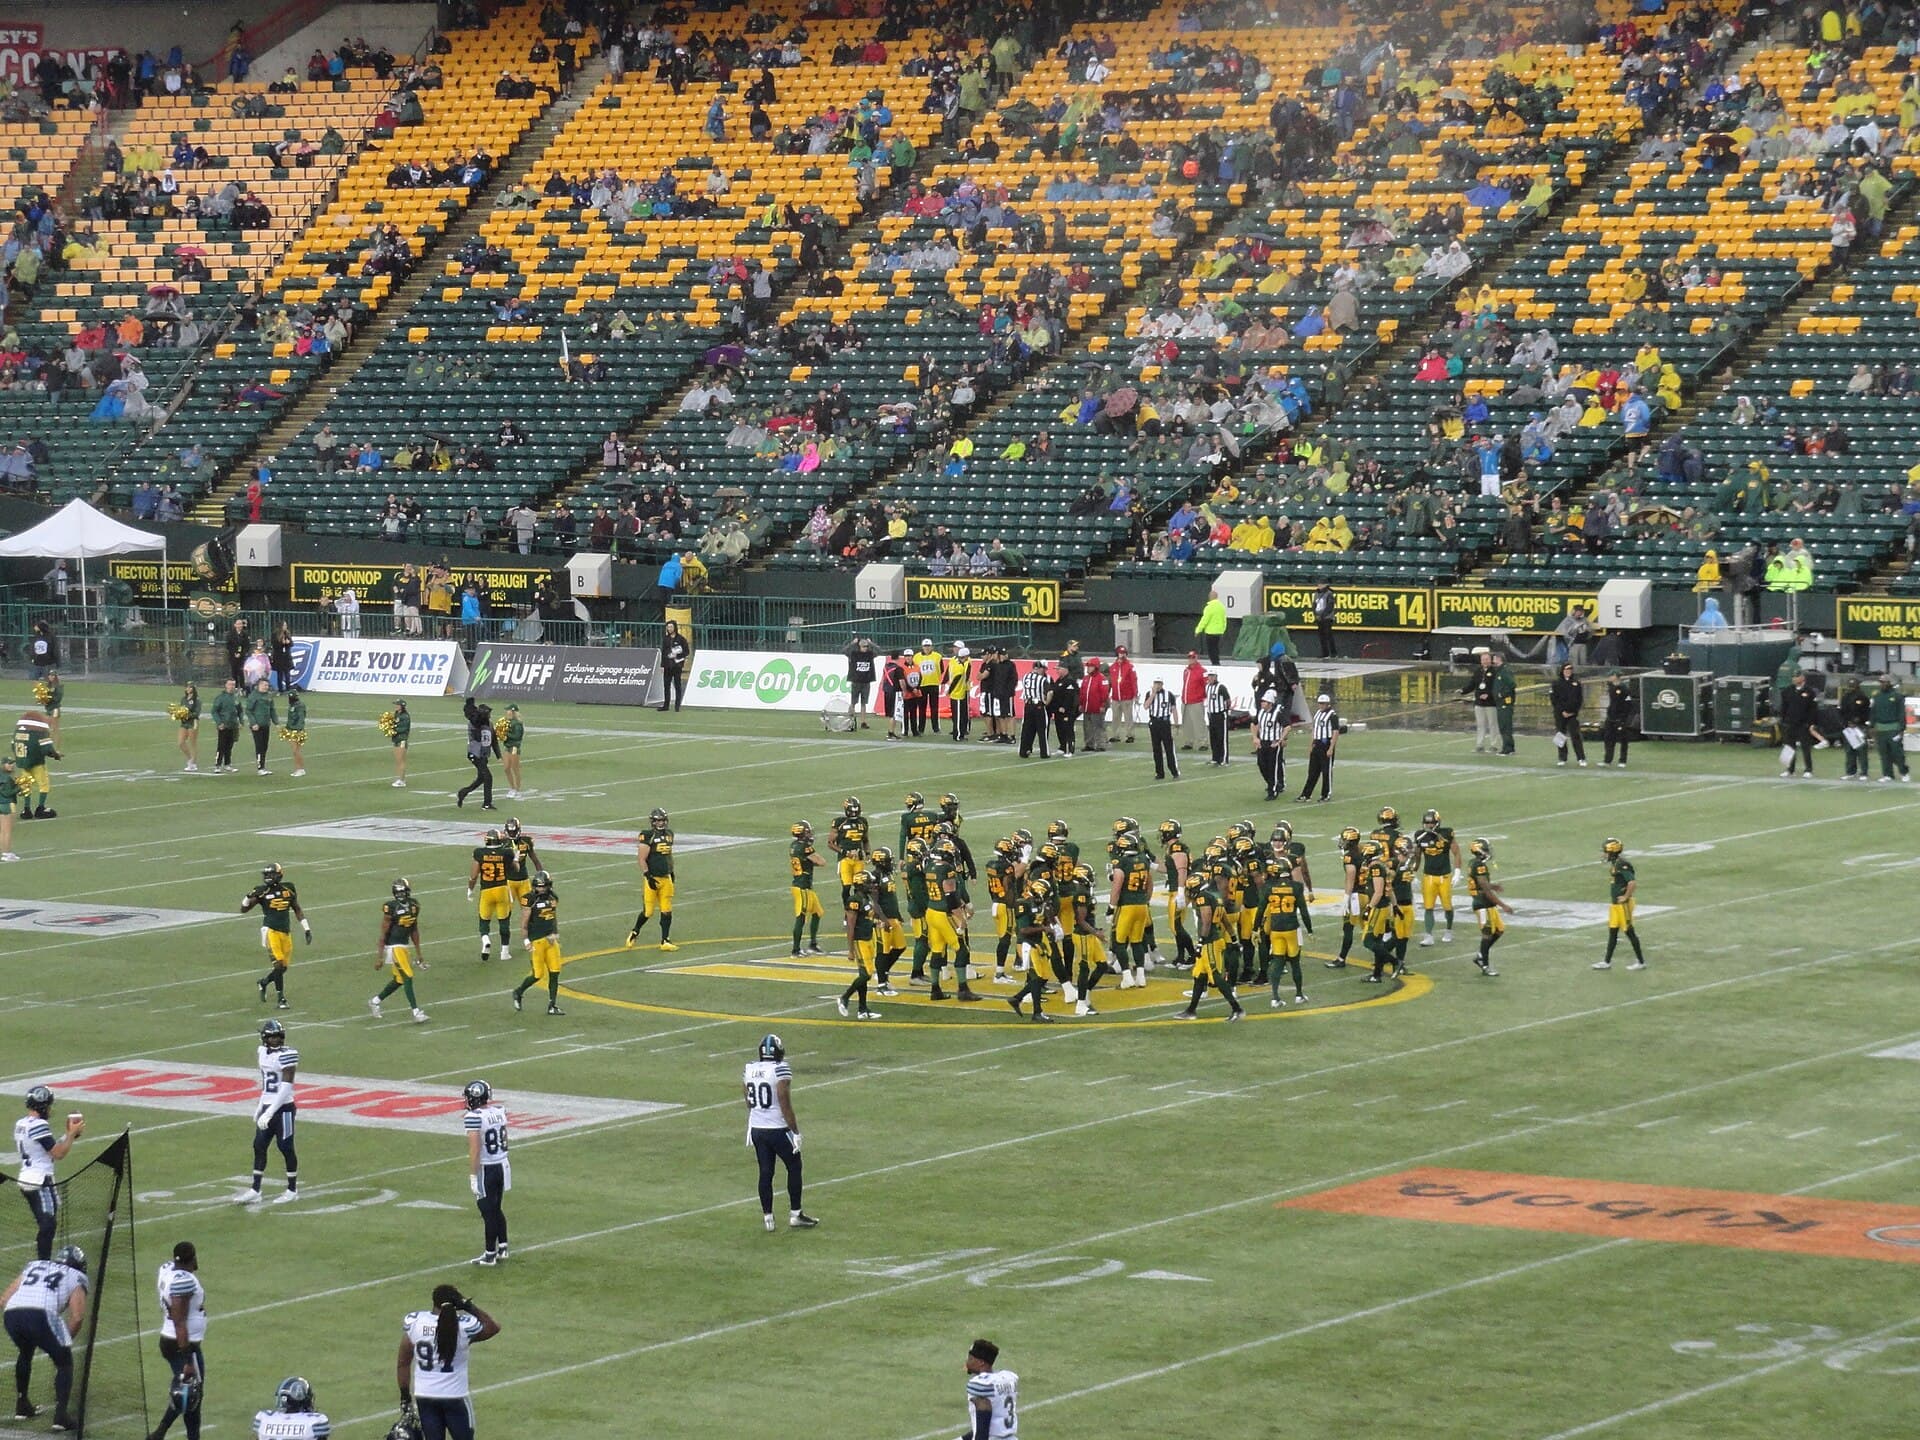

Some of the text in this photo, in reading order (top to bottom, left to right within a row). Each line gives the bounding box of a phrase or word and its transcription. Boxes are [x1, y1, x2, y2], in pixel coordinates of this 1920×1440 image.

[249, 547, 256, 560] A
[116, 565, 158, 581] HECTOR
[304, 569, 382, 585] ROD CONNOP
[577, 575, 585, 588] B
[869, 586, 877, 600] C
[919, 583, 1054, 617] DANNY BASS 30
[1227, 595, 1235, 609] D
[1271, 592, 1314, 608] OSCA
[1394, 594, 1426, 626] 14
[1441, 596, 1494, 612] FRANK
[1497, 597, 1561, 614] MORRIS
[1615, 604, 1623, 618] E
[1848, 604, 1901, 623] NORM
[1471, 615, 1535, 629] 1950-1958
[321, 650, 449, 672] ARE YOU IN?
[500, 653, 557, 664] WILLIAM
[493, 662, 555, 685] HUFF
[564, 663, 652, 678] Exclusive signage supplier
[563, 675, 647, 687] of the Edmonton Eskimos
[697, 668, 756, 690] save
[758, 671, 792, 691] on
[1398, 1181, 1824, 1235] Kubota
[22, 1266, 65, 1292] 54
[1003, 1395, 1015, 1430] 3
[265, 1423, 306, 1436] PFEFFER
